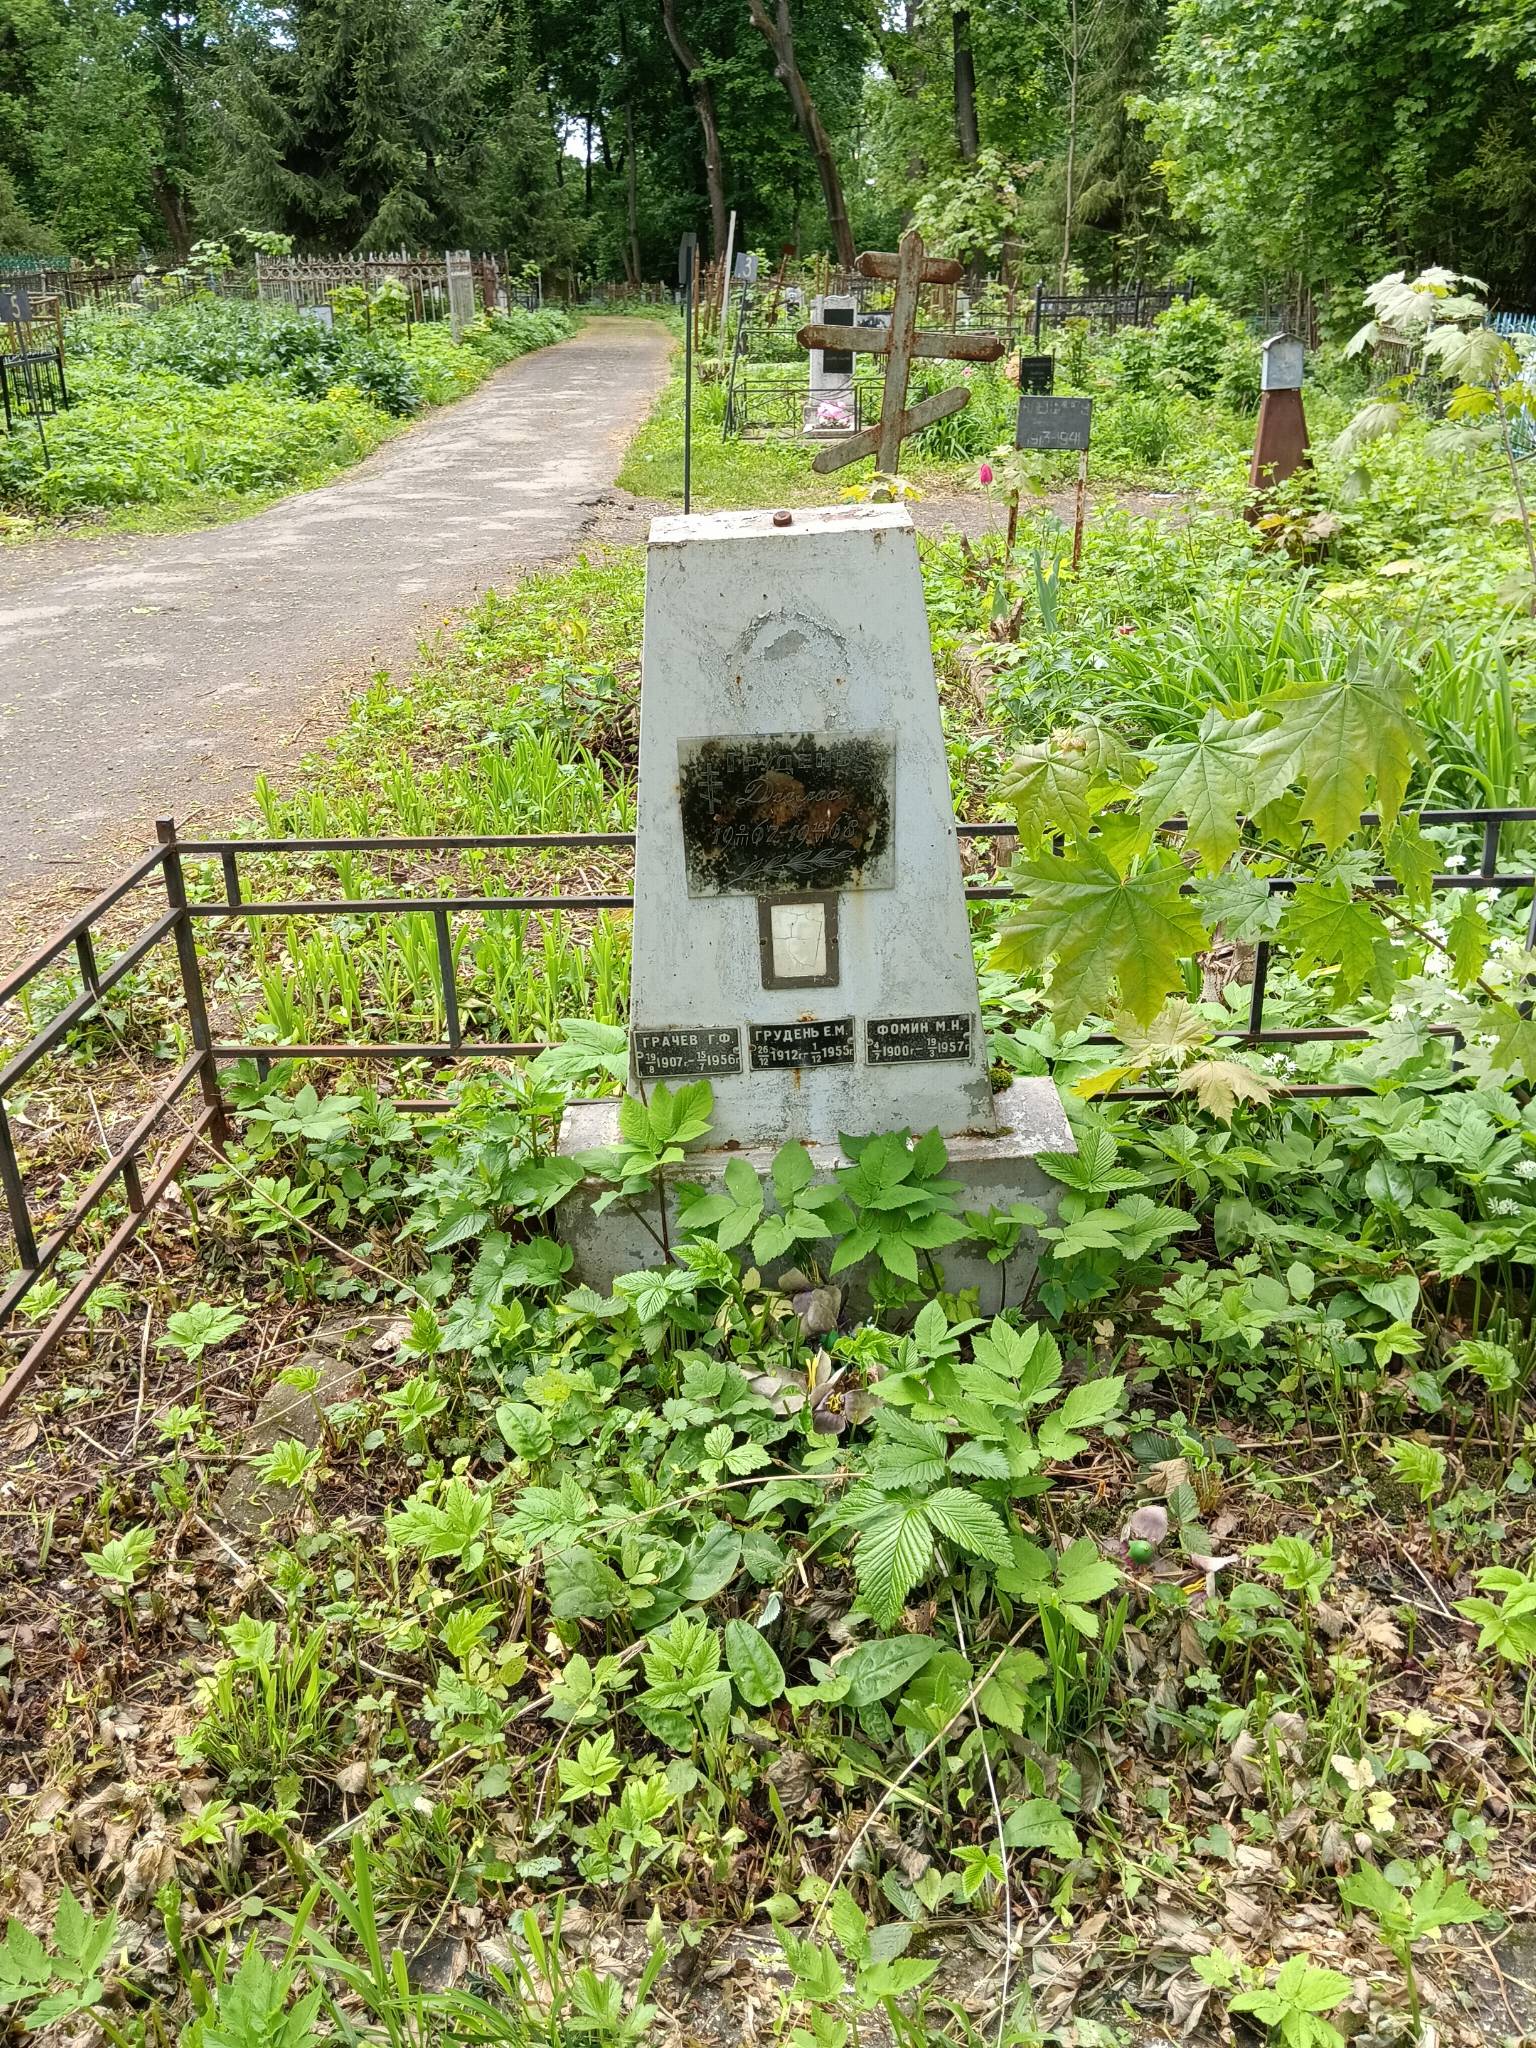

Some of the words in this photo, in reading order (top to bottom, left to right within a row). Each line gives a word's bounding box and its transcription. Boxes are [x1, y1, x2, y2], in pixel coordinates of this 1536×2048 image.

[10, 295, 21, 319] 5
[755, 1027, 820, 1042] ГРУДЕНЬ
[824, 1024, 849, 1037] Е.М.
[877, 1022, 929, 1035] ФОМИН
[935, 1019, 964, 1032] М.Н.
[642, 1035, 698, 1048] ГРАЧЕВ
[708, 1033, 734, 1045] Г.Ф.
